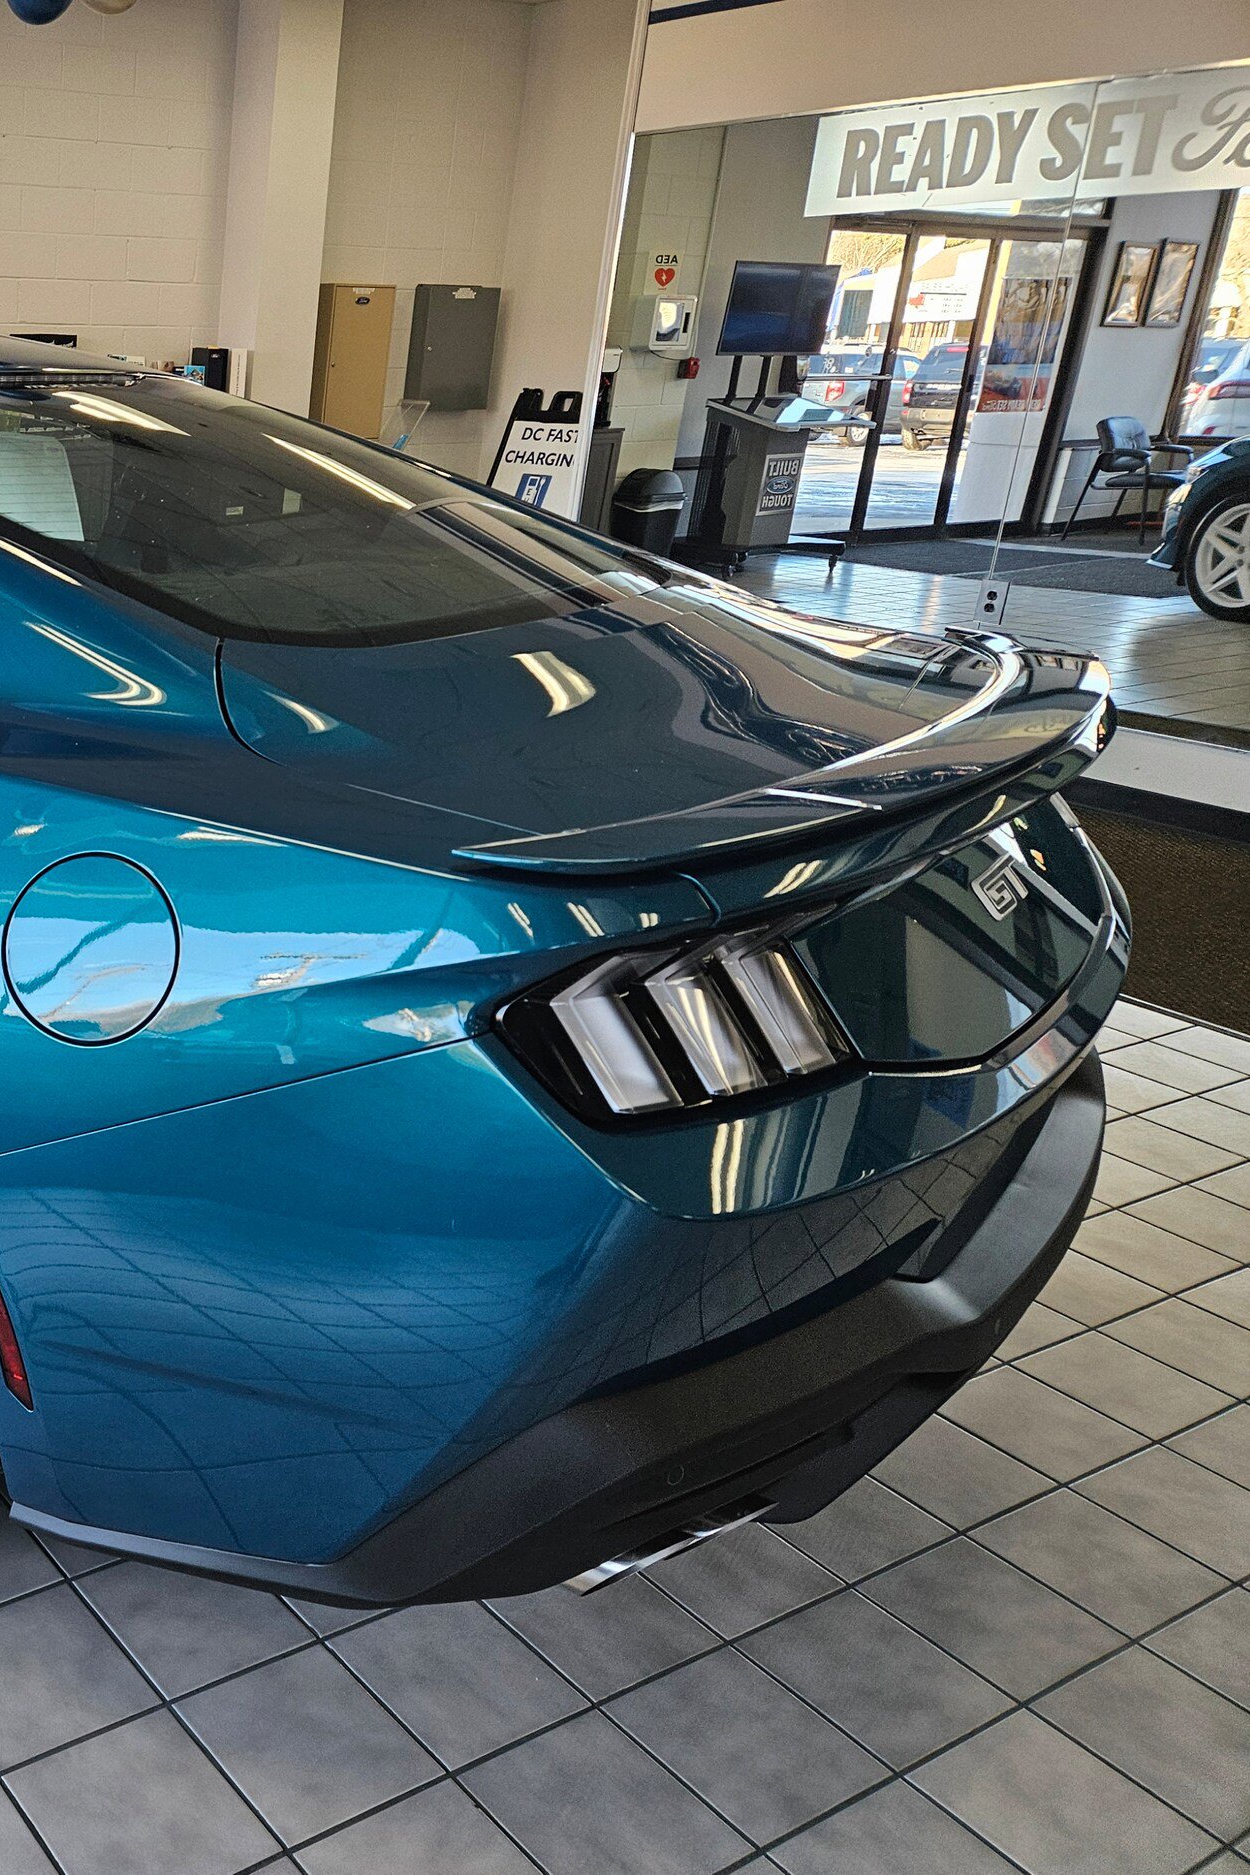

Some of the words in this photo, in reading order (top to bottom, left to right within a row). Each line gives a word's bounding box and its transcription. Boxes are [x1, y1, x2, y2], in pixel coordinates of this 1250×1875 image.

[836, 107, 1039, 199] READY
[1039, 93, 1180, 181] SET
[521, 427, 545, 441] DC
[546, 428, 579, 444] FAST
[505, 449, 575, 468] CHARGIN
[970, 852, 1029, 922] GT
